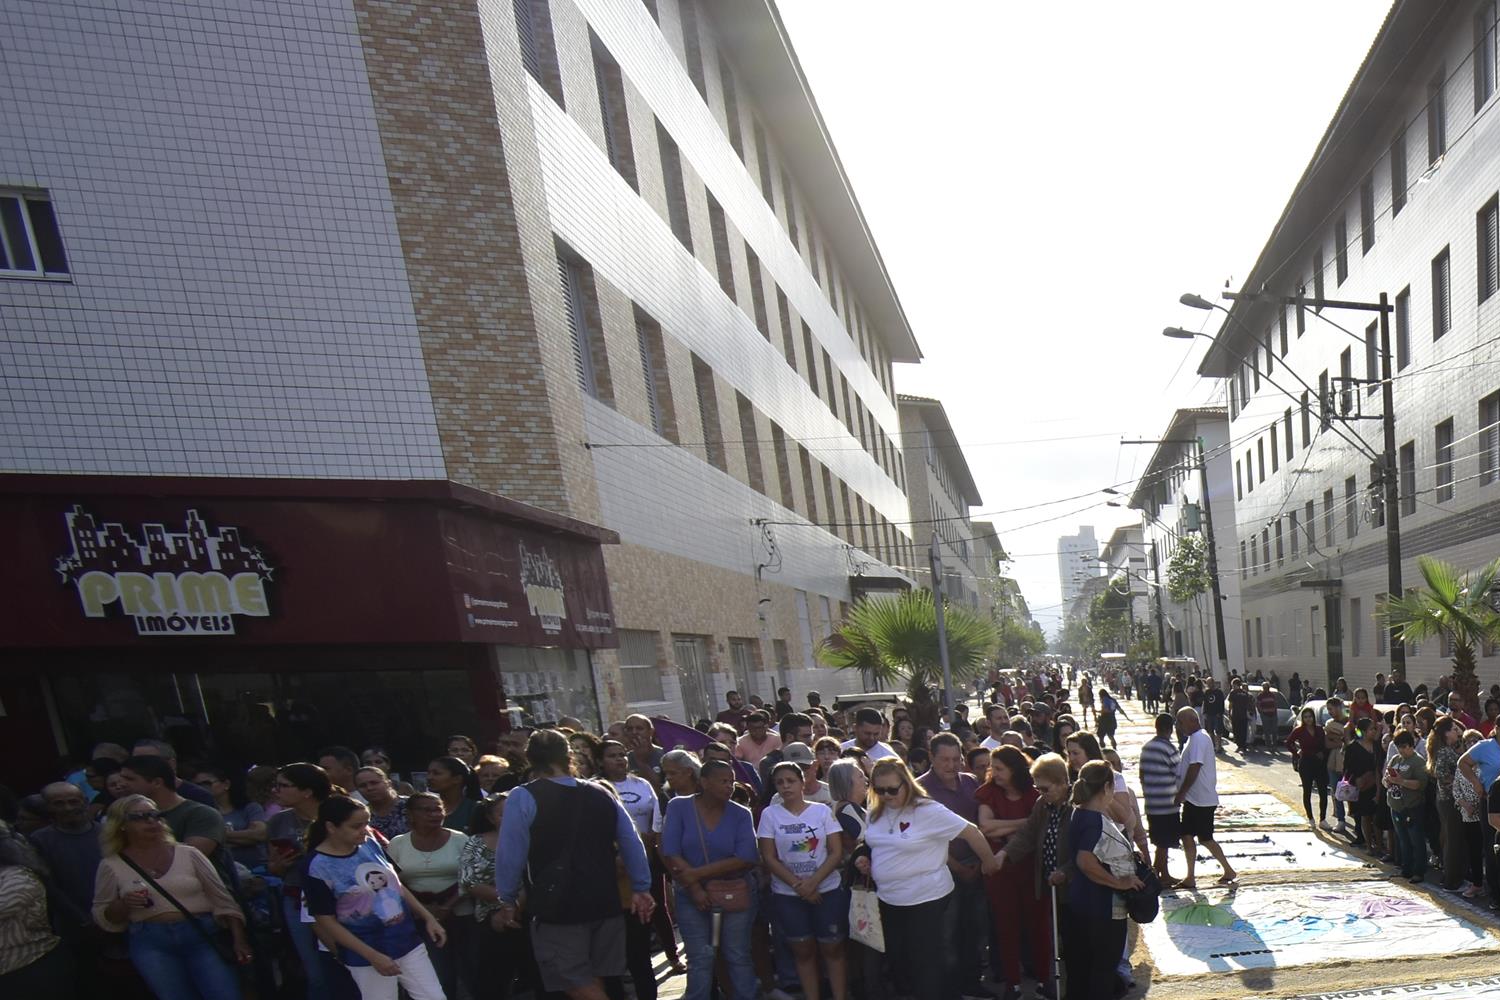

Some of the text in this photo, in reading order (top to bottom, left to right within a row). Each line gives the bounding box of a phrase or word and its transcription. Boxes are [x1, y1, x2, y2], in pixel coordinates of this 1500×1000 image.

[79, 571, 267, 617] PRIME
[136, 612, 232, 632] IMÓVEIS
[1404, 983, 1438, 994] DO
